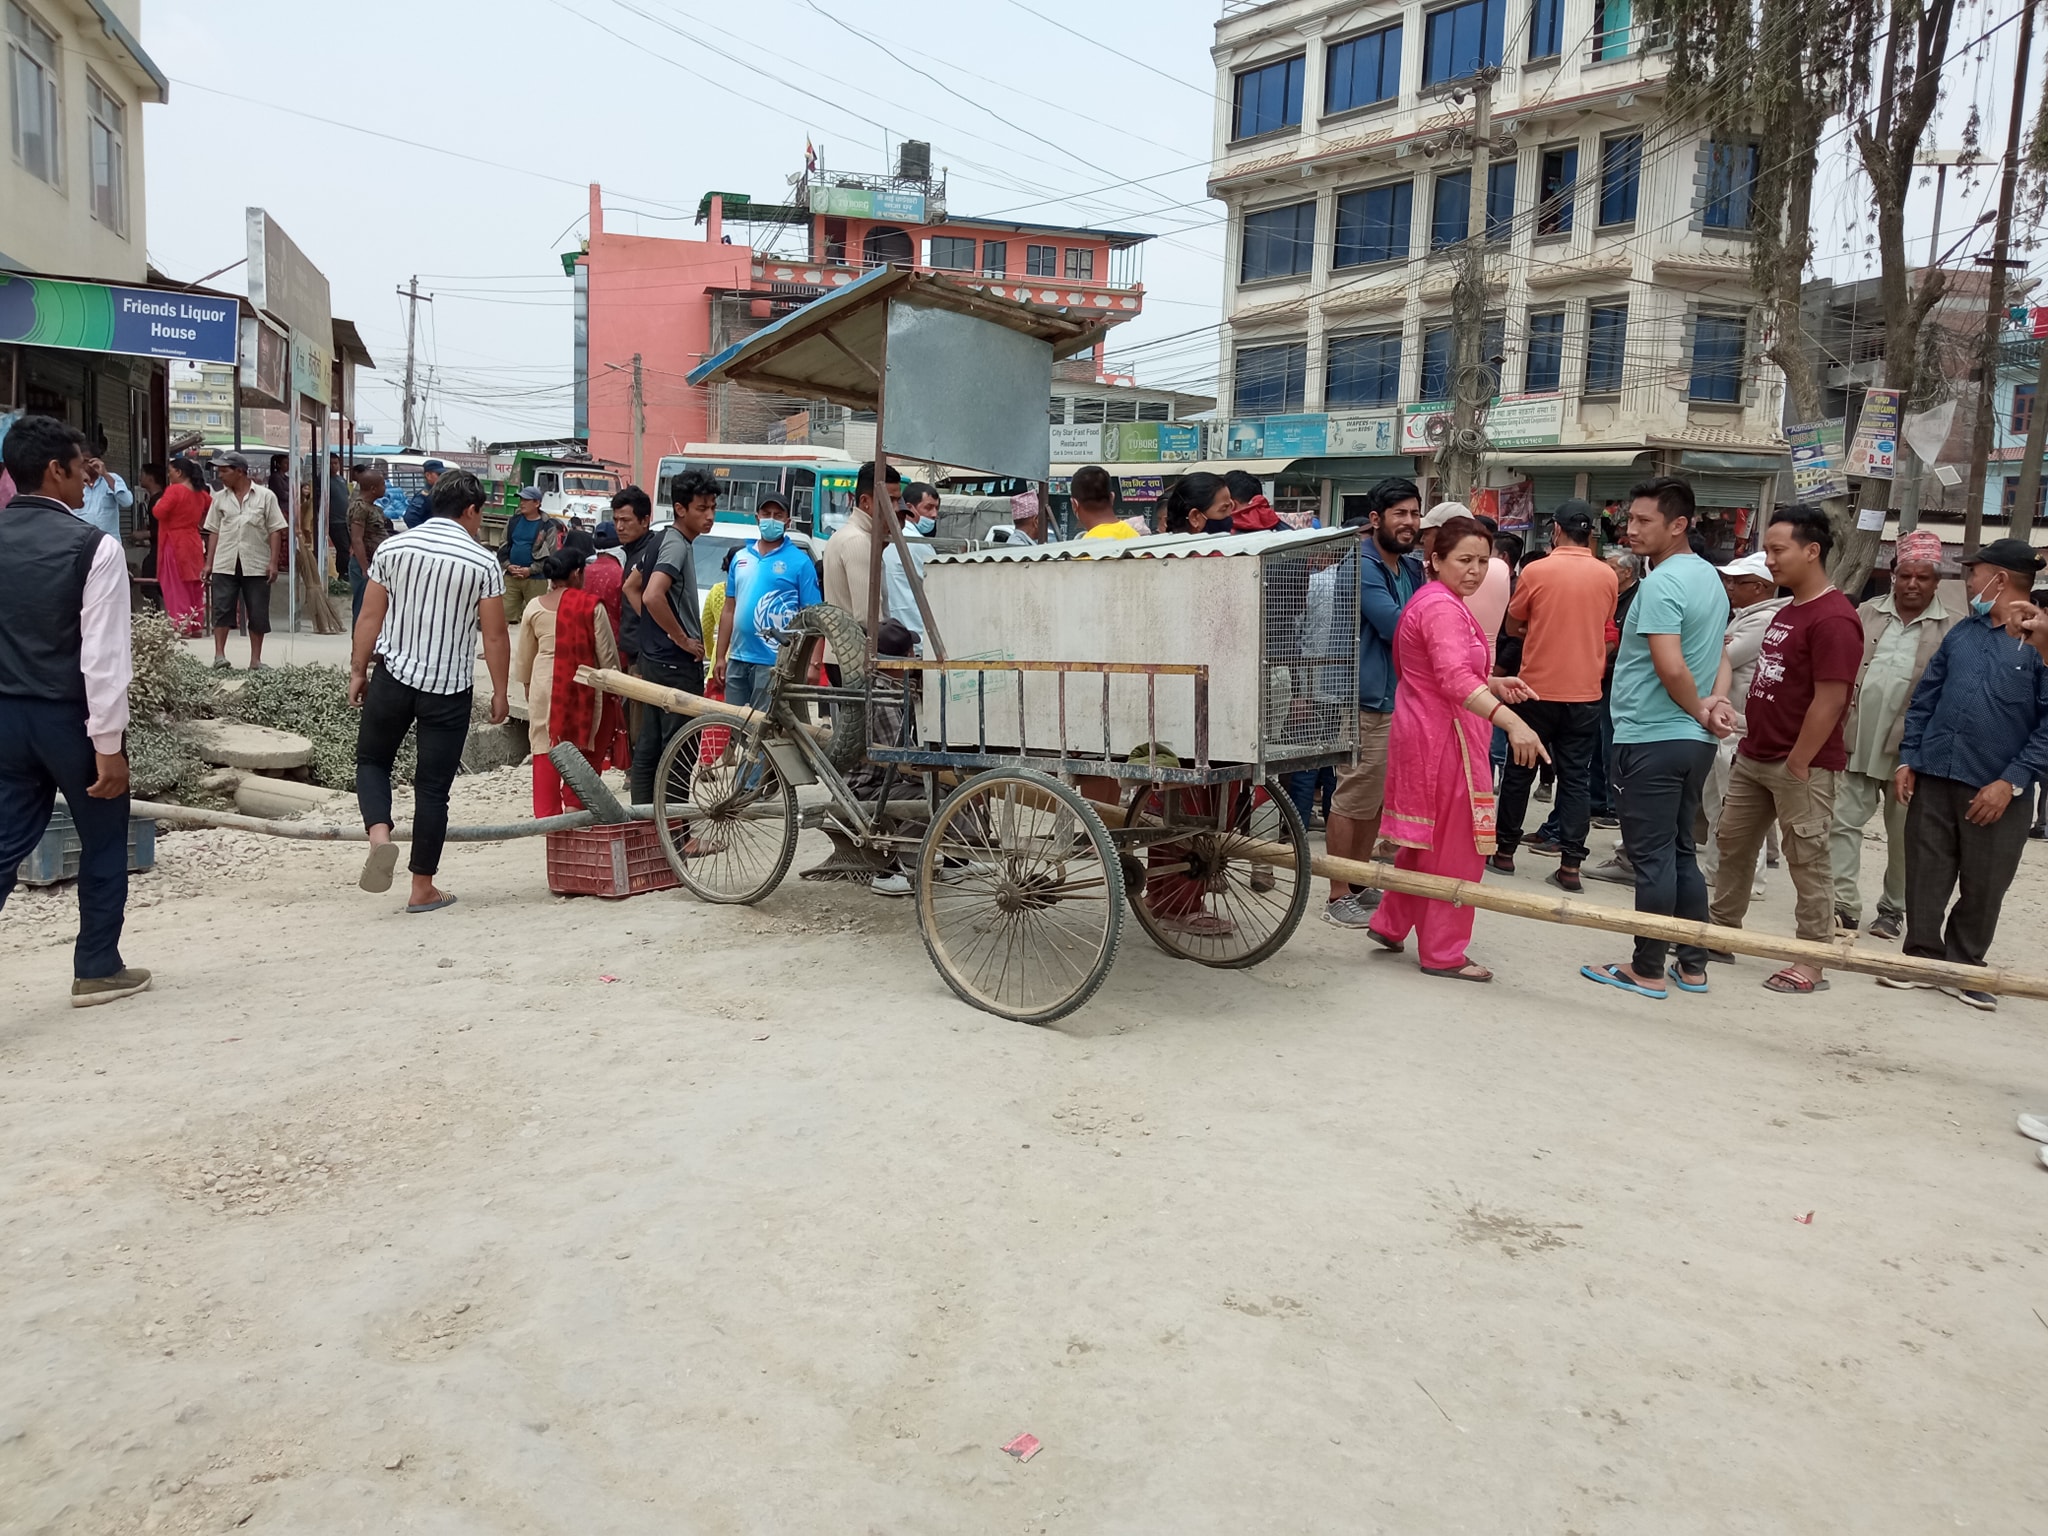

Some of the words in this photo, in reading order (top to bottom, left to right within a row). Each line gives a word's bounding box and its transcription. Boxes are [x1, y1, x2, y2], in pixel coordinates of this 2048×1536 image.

[123, 297, 177, 318] Friends
[180, 303, 226, 323] Liquor
[151, 322, 197, 341] House
[1052, 429, 1061, 437] City
[1074, 428, 1085, 436] Fast
[1086, 428, 1099, 436] Food
[1790, 421, 1823, 433] Admission
[1824, 418, 1844, 427] Open!
[1128, 438, 1158, 449] TUBORG
